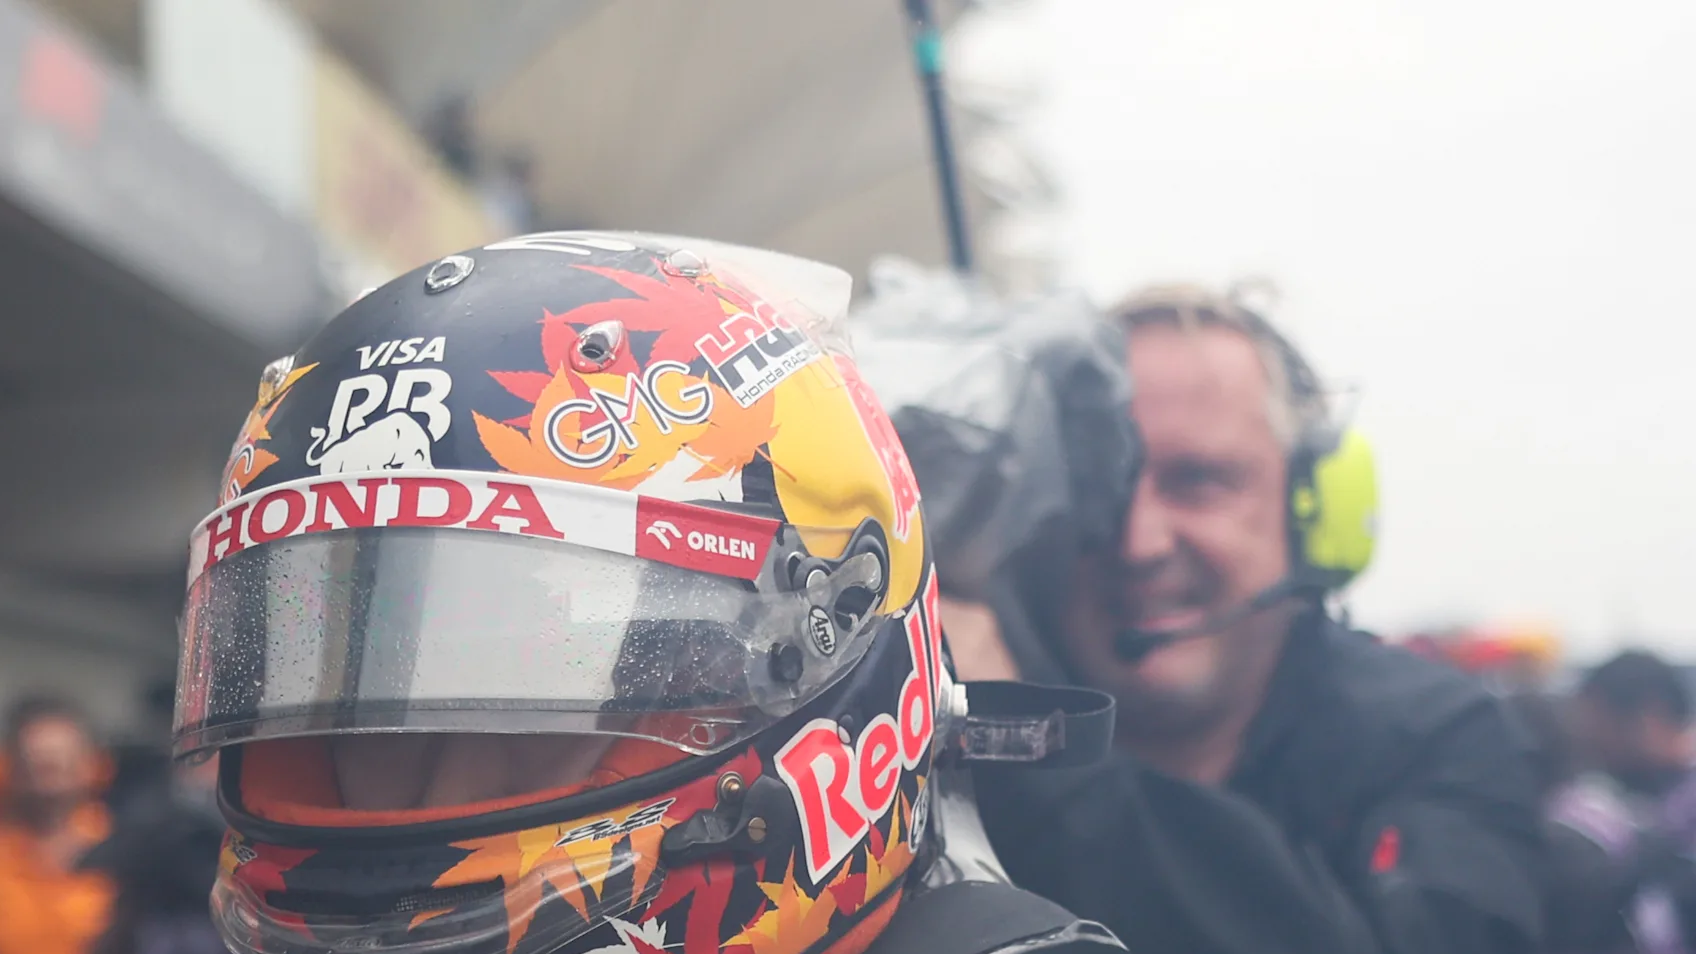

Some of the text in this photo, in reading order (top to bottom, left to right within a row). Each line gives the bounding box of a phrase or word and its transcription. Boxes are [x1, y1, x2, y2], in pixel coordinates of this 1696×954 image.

[356, 336, 447, 370] VISA
[737, 368, 784, 405] Honda
[543, 360, 714, 468] GMG
[203, 477, 565, 570] HONDA
[687, 531, 755, 561] ORLEN
